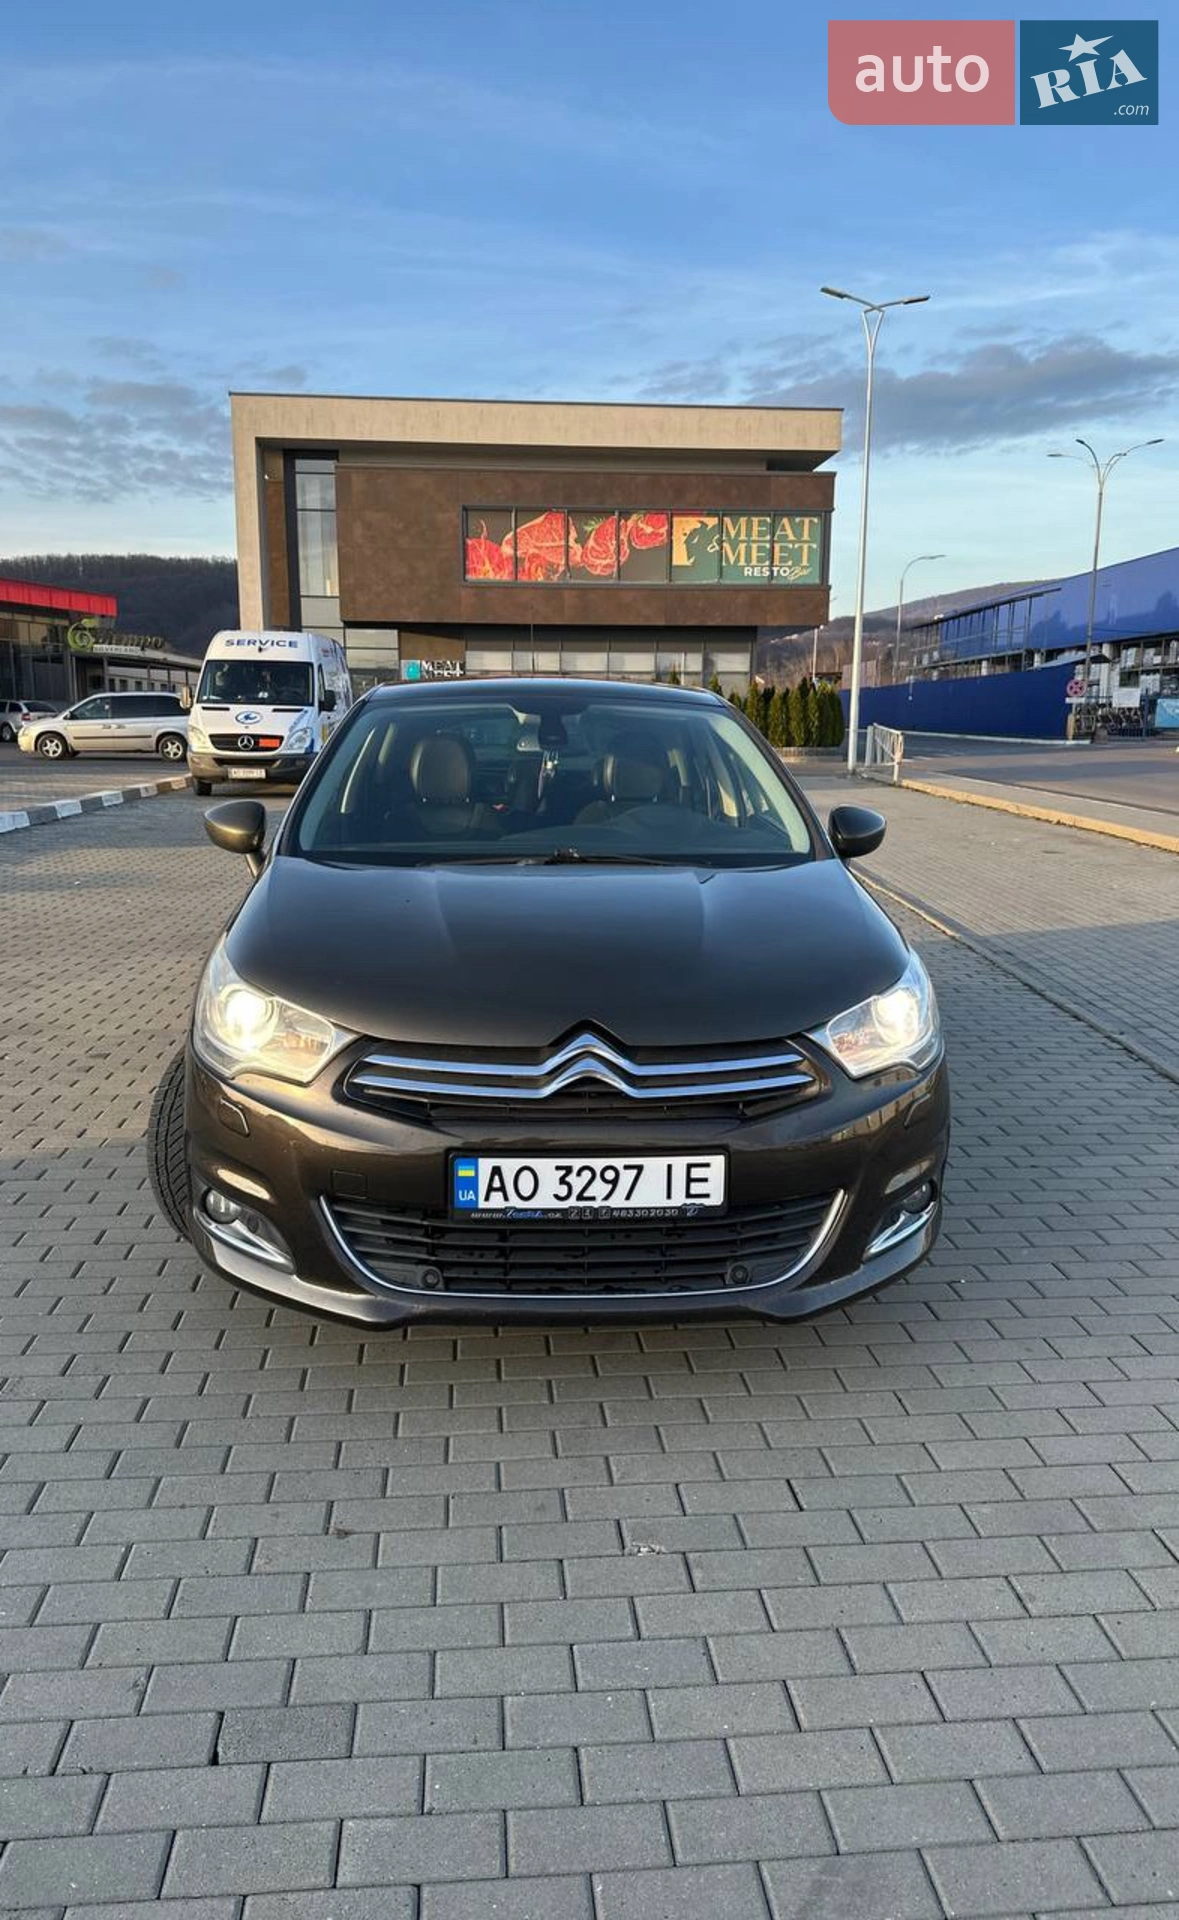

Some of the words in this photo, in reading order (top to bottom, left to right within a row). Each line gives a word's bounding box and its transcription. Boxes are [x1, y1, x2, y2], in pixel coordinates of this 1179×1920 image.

[722, 516, 818, 541] MEAT
[722, 541, 817, 566] MEET
[744, 566, 789, 577] RESTO
[224, 638, 298, 649] SERVICE
[483, 1165, 540, 1202] AO
[553, 1164, 644, 1202] 3297
[666, 1162, 712, 1200] IE
[459, 1190, 476, 1201] UA
